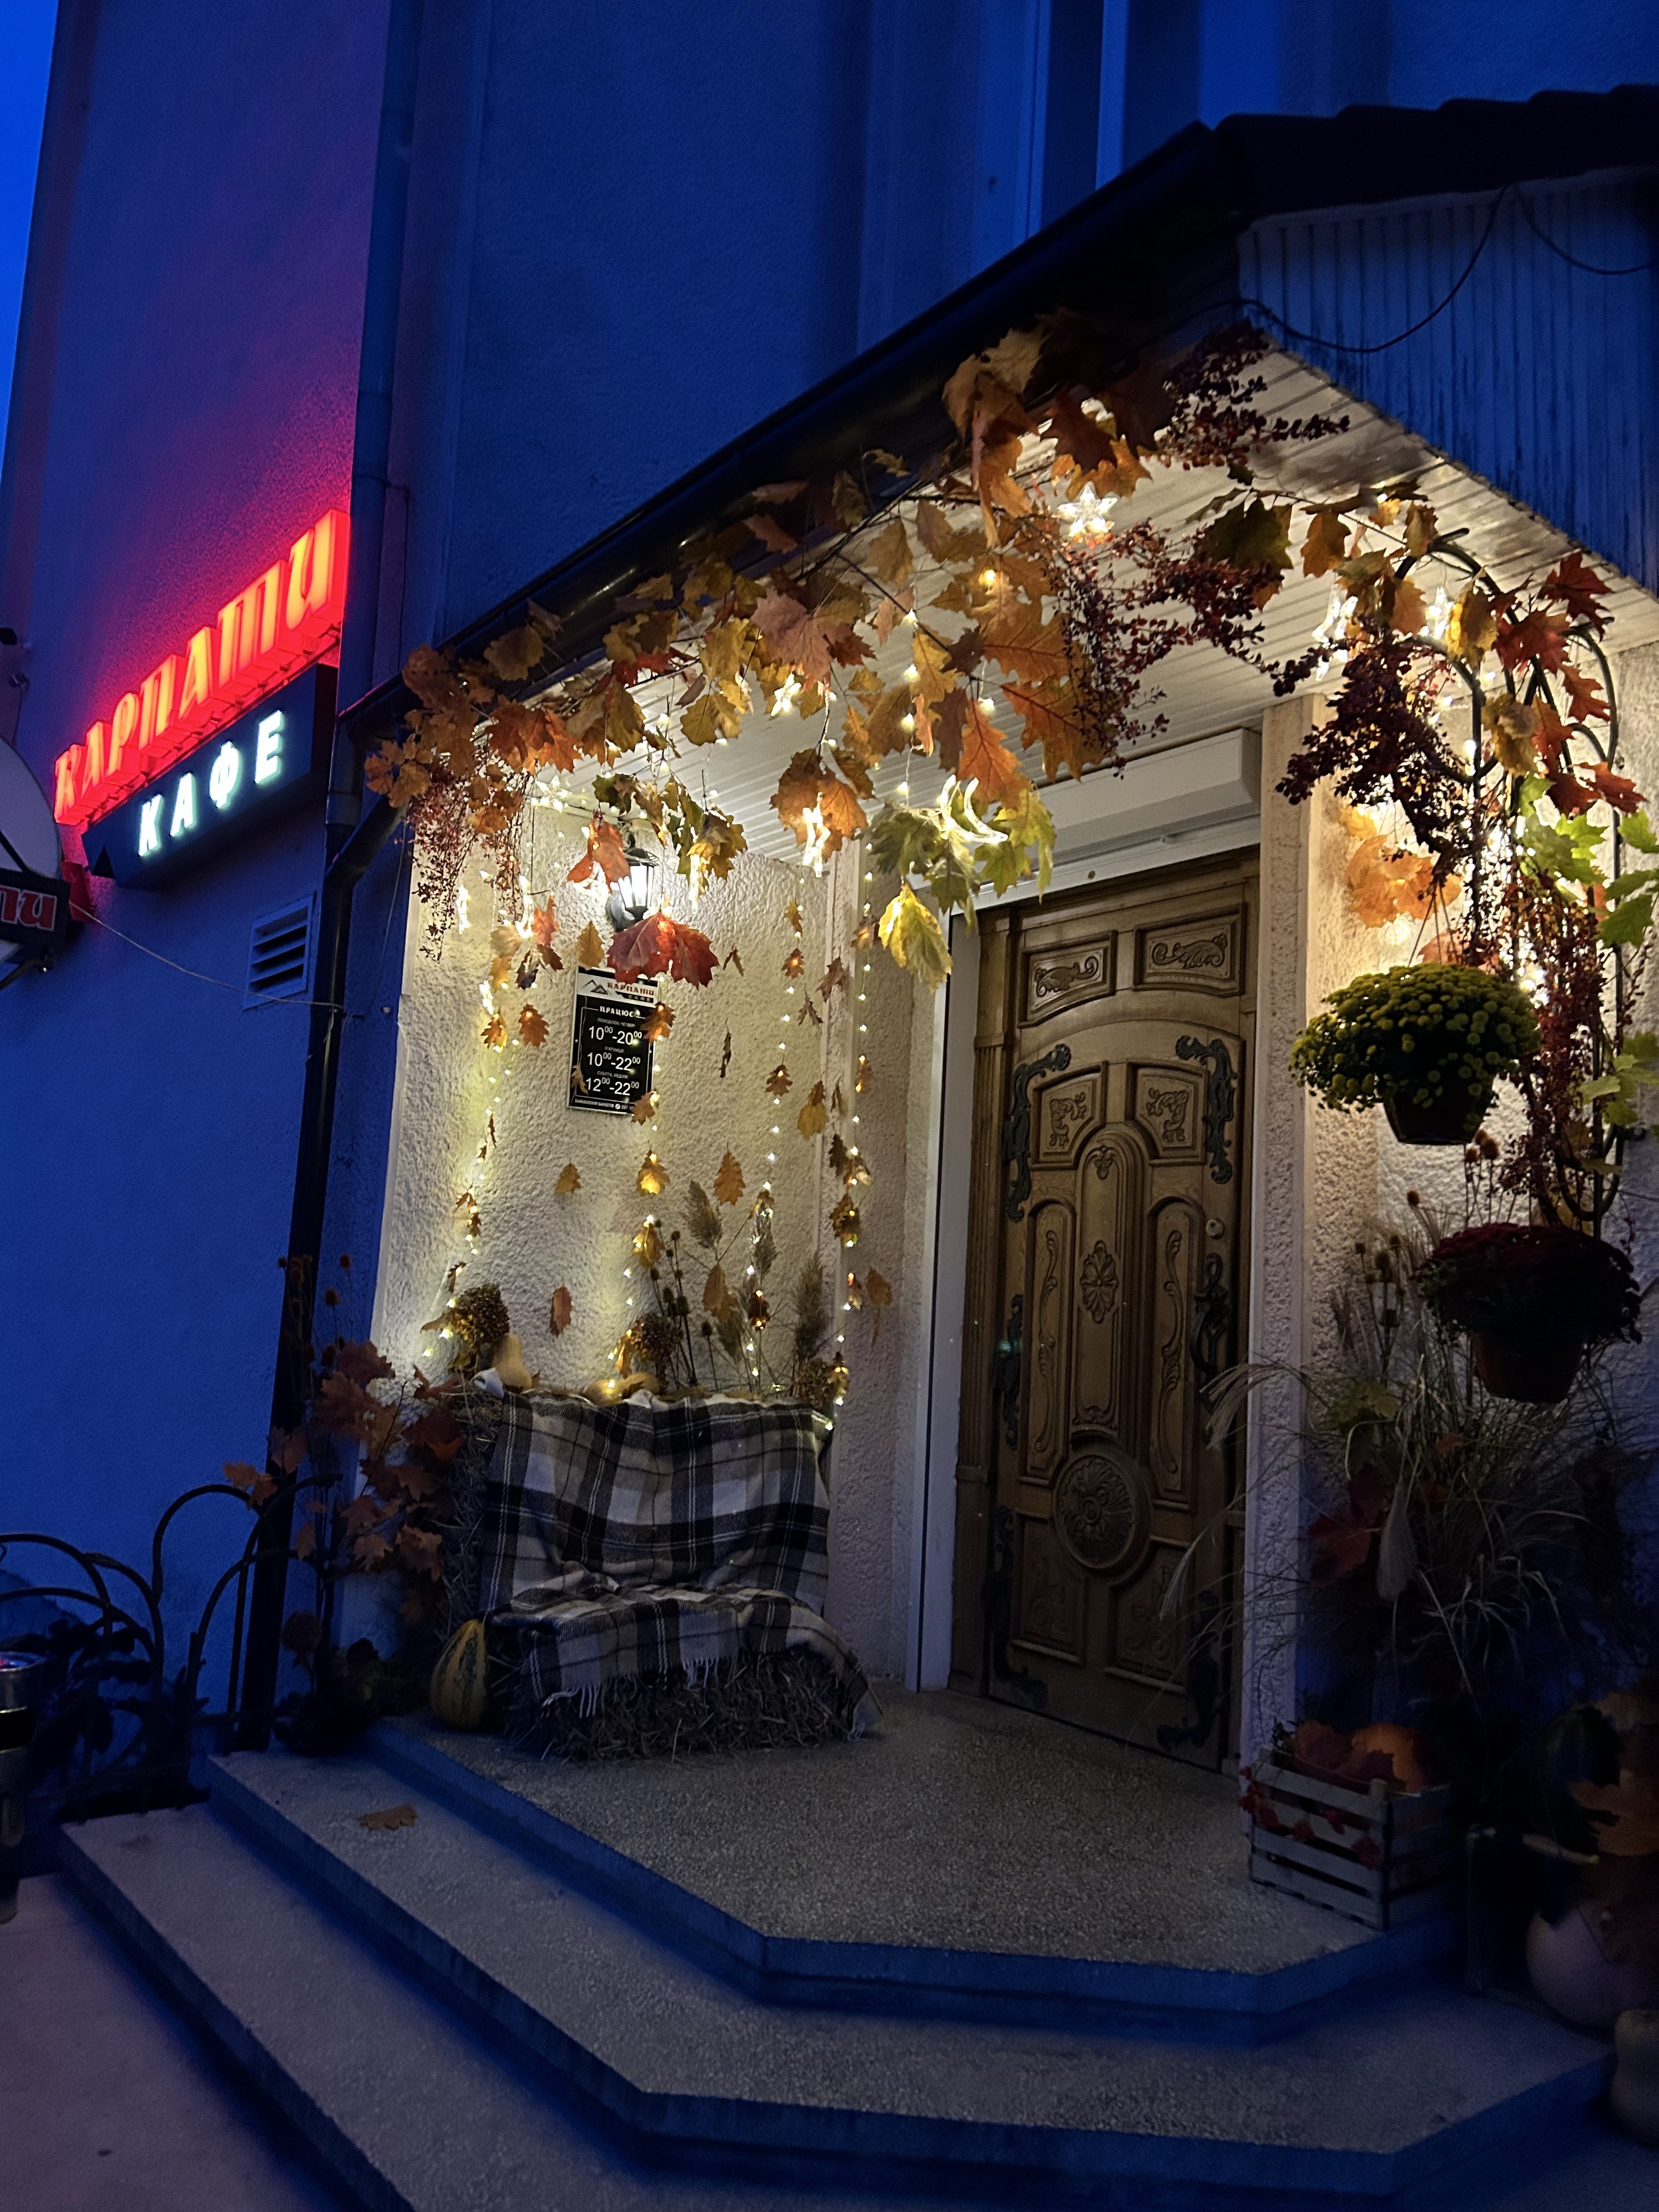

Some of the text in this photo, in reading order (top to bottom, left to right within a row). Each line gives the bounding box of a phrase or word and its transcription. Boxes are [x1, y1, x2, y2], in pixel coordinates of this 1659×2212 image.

[54, 509, 349, 824] КАРПАТИ
[138, 709, 286, 857] КАФЕ
[600, 1006, 634, 1018] ПРАЦЮЄ
[607, 982, 654, 996] КАРПАТИ
